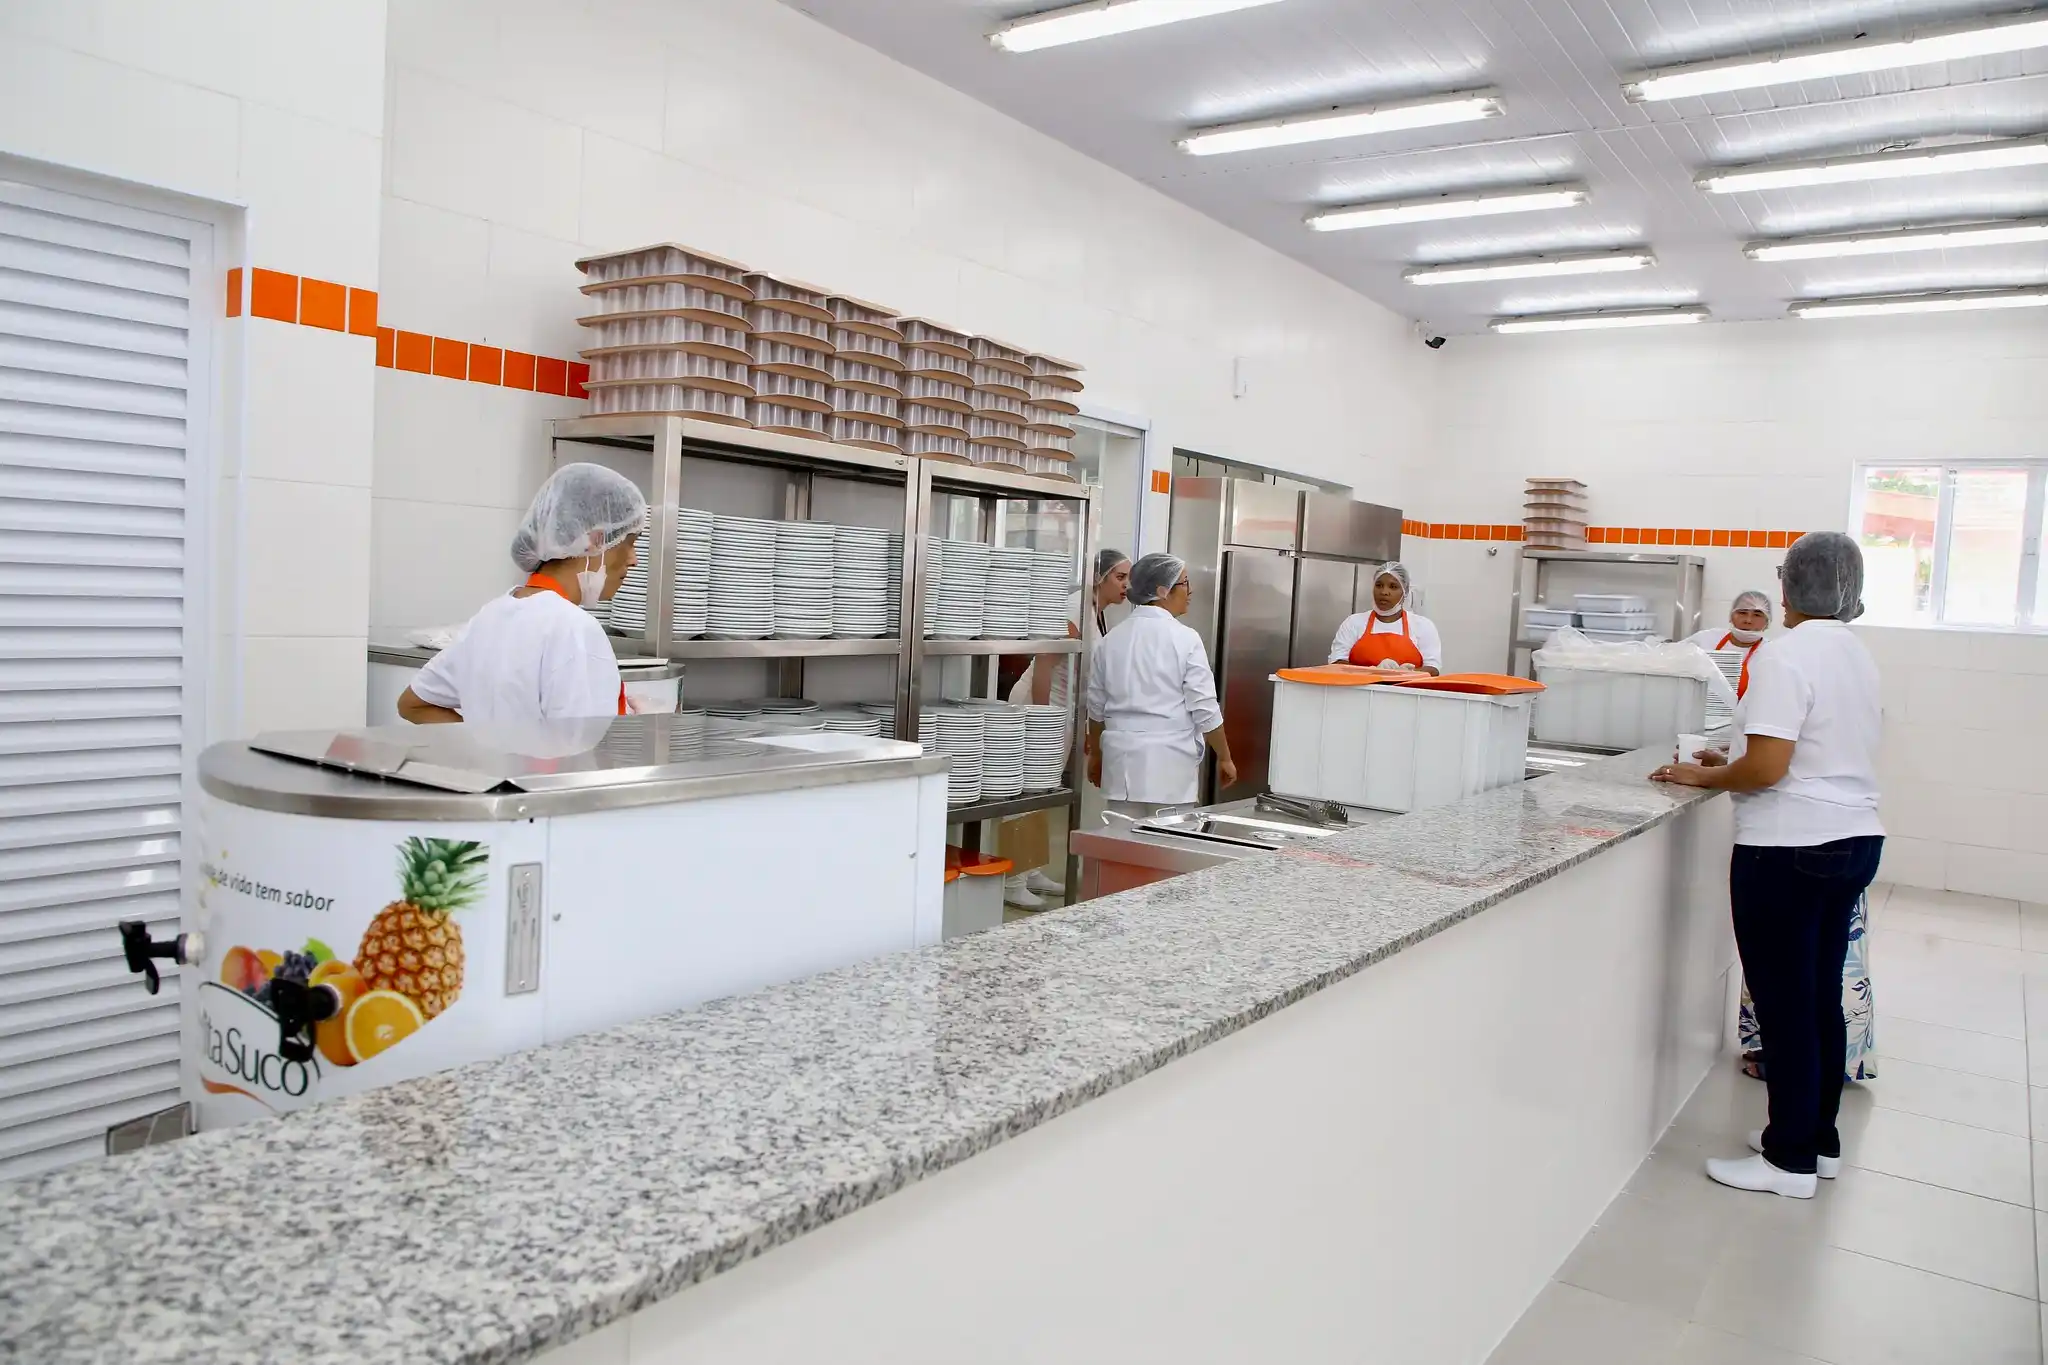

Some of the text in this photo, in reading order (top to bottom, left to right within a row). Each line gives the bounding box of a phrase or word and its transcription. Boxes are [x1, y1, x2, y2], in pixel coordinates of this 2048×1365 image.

[229, 872, 253, 895] vida
[255, 881, 281, 903] tem
[284, 889, 335, 912] sabor
